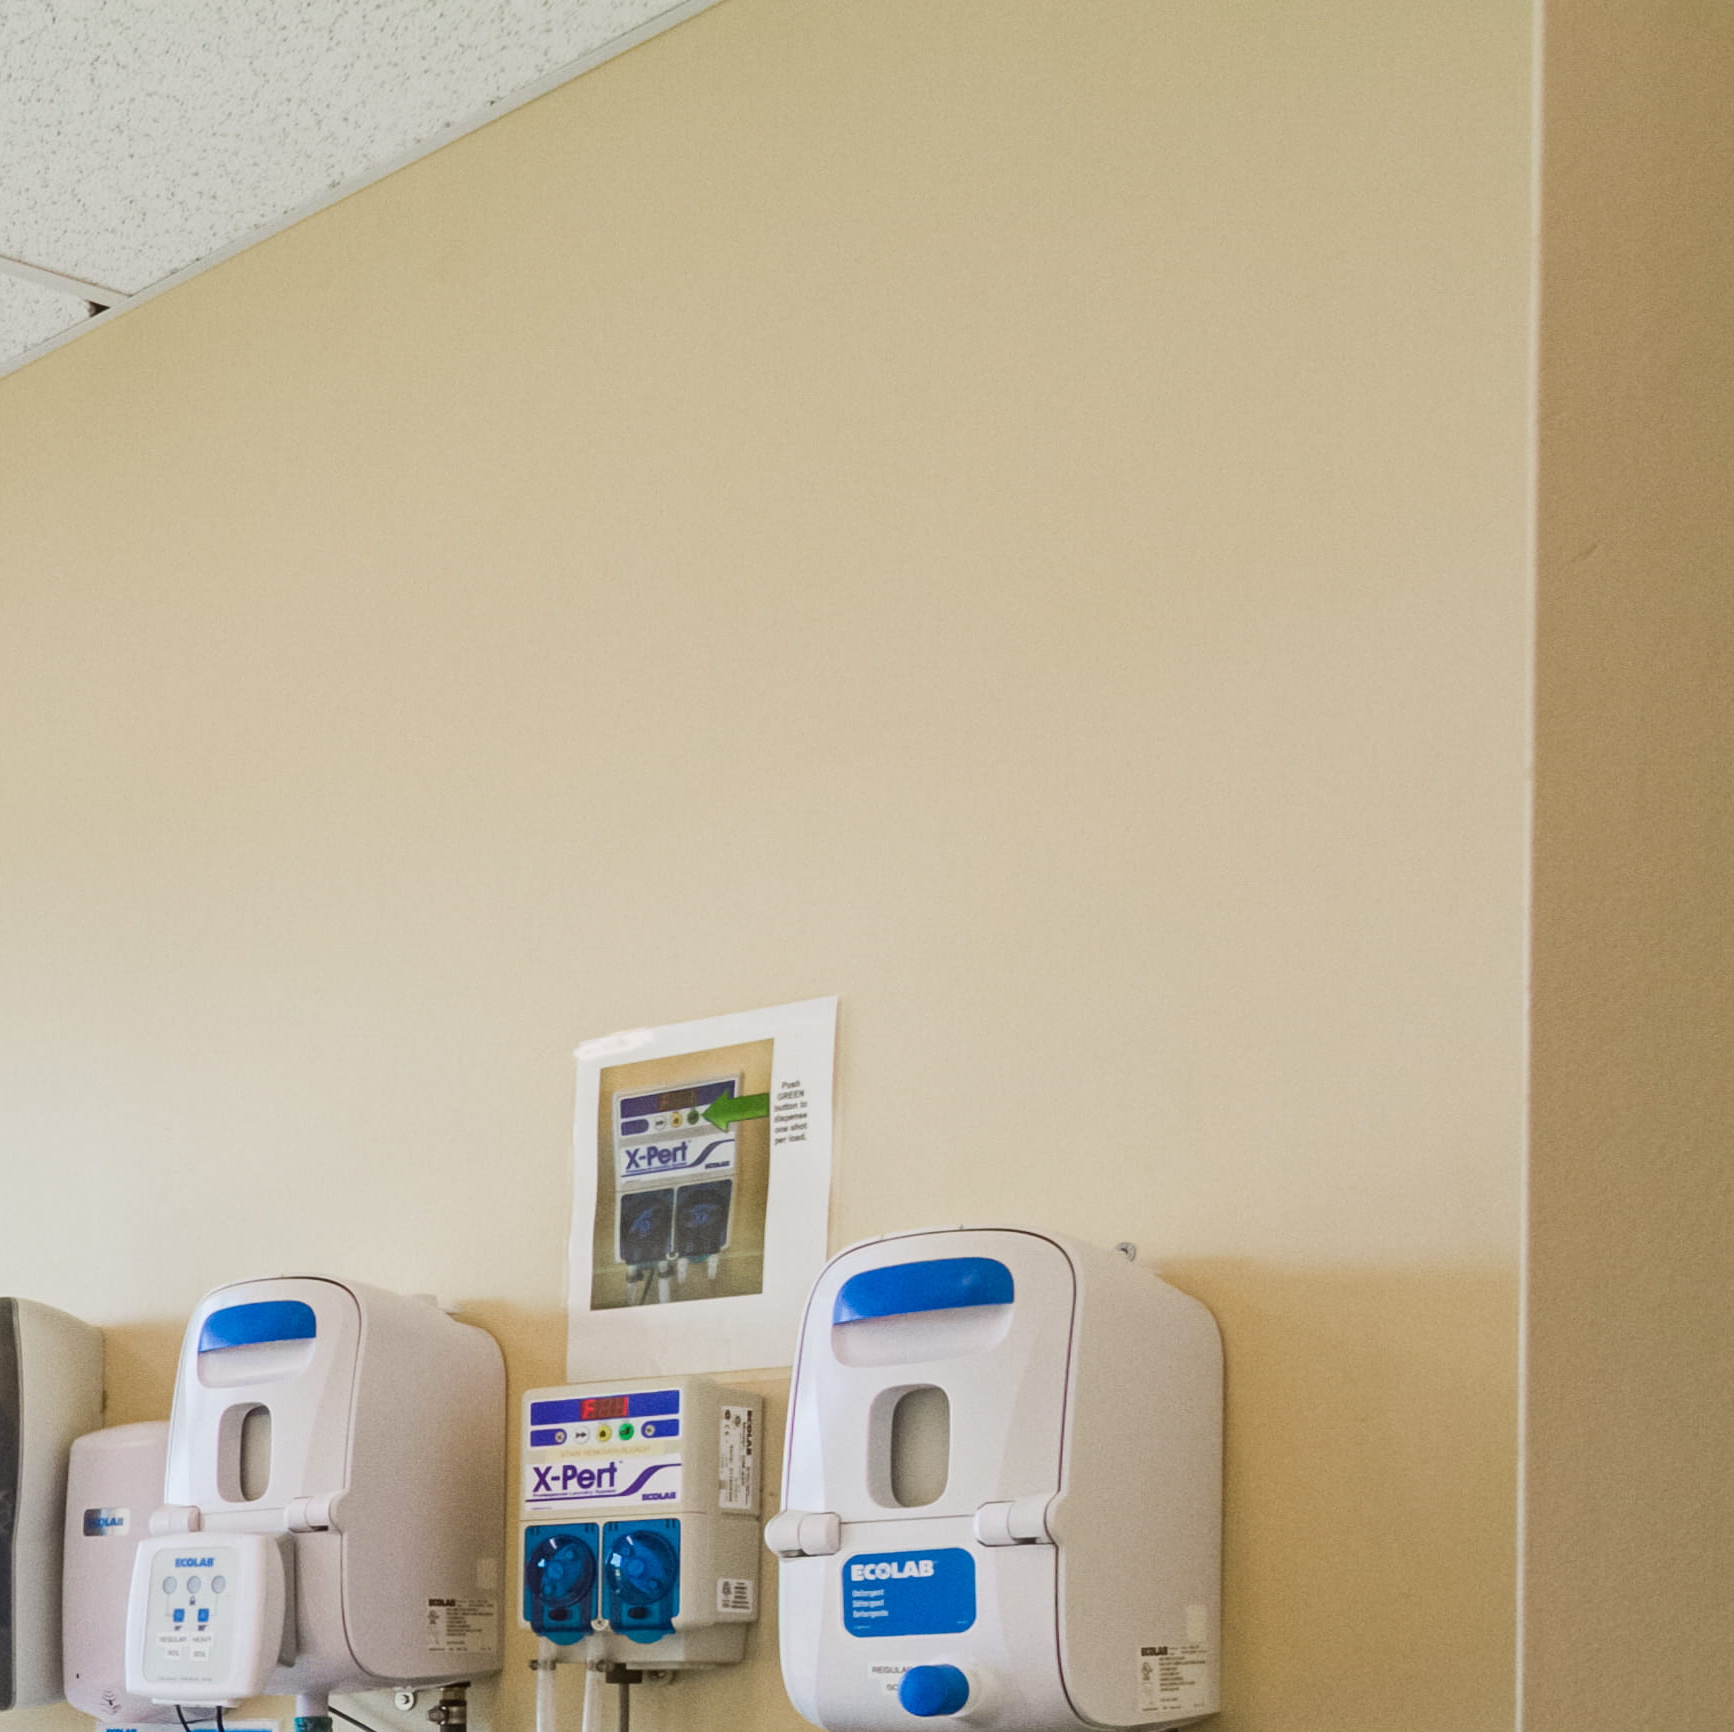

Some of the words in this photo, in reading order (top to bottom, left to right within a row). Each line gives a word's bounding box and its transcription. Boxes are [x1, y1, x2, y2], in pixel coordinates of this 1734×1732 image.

[777, 1090, 805, 1100] GREEN
[774, 1103, 798, 1112] button
[625, 1141, 688, 1169] X-Pert
[532, 1461, 617, 1492] X-Pert
[642, 1492, 676, 1501] ECOLAB
[175, 1558, 214, 1567] ECOLAB
[851, 1560, 934, 1581] ECOLAB
